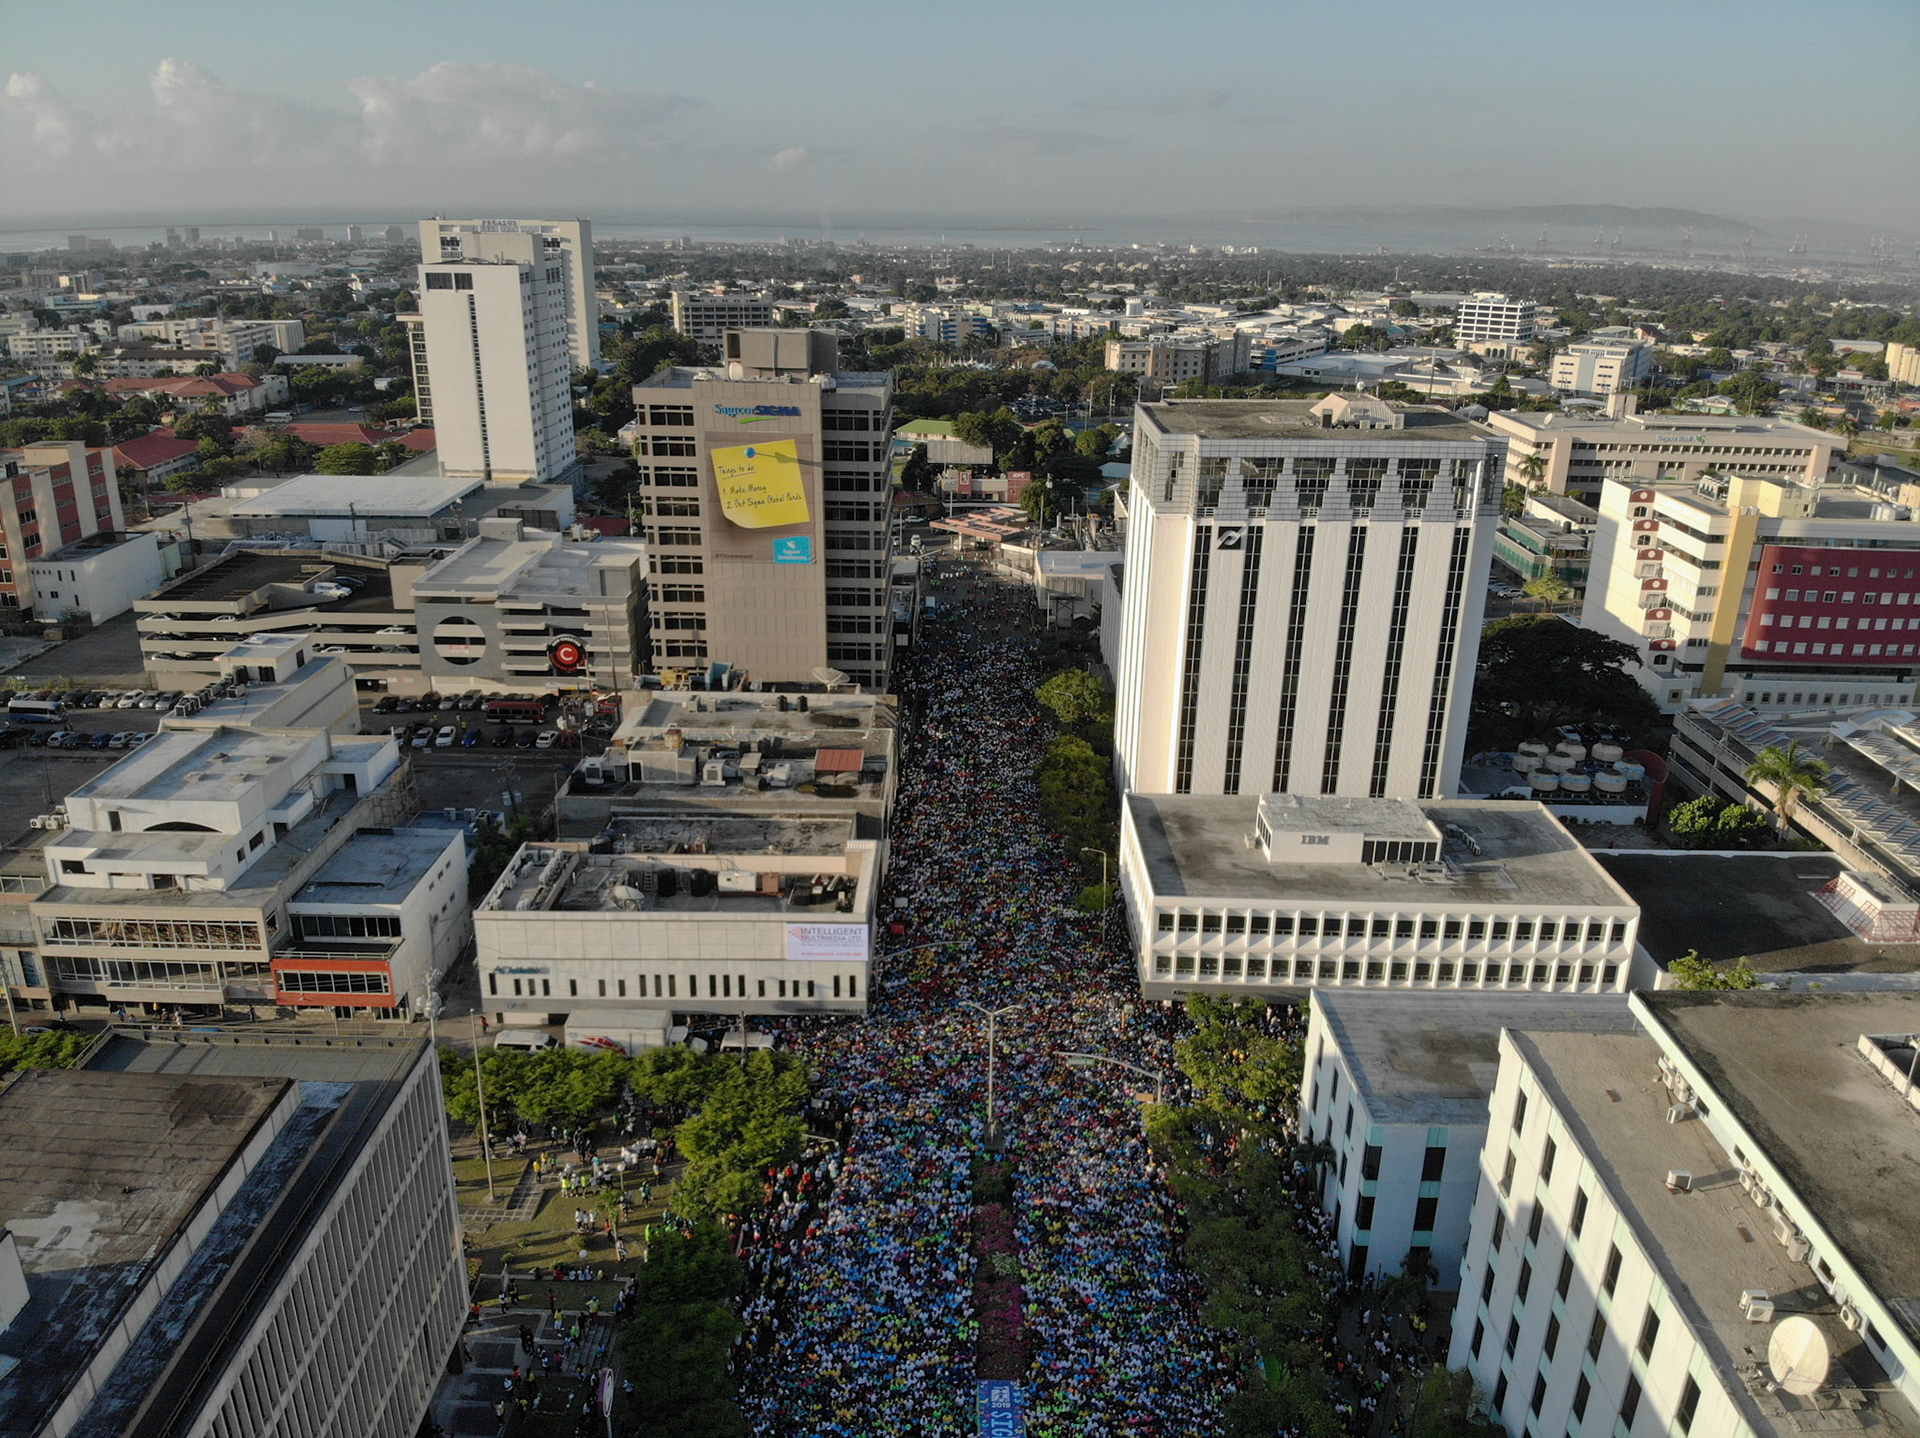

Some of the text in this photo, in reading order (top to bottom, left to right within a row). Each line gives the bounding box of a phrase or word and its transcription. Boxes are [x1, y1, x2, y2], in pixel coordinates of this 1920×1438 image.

[718, 466, 736, 477] Things
[730, 486, 746, 495] Make
[748, 483, 766, 493] Money
[747, 497, 765, 509] Sigma
[767, 494, 784, 504] Global
[787, 492, 802, 501] Funds
[560, 647, 573, 661] C
[1301, 834, 1330, 845] IBM
[801, 927, 863, 936] INTELLIGENT
